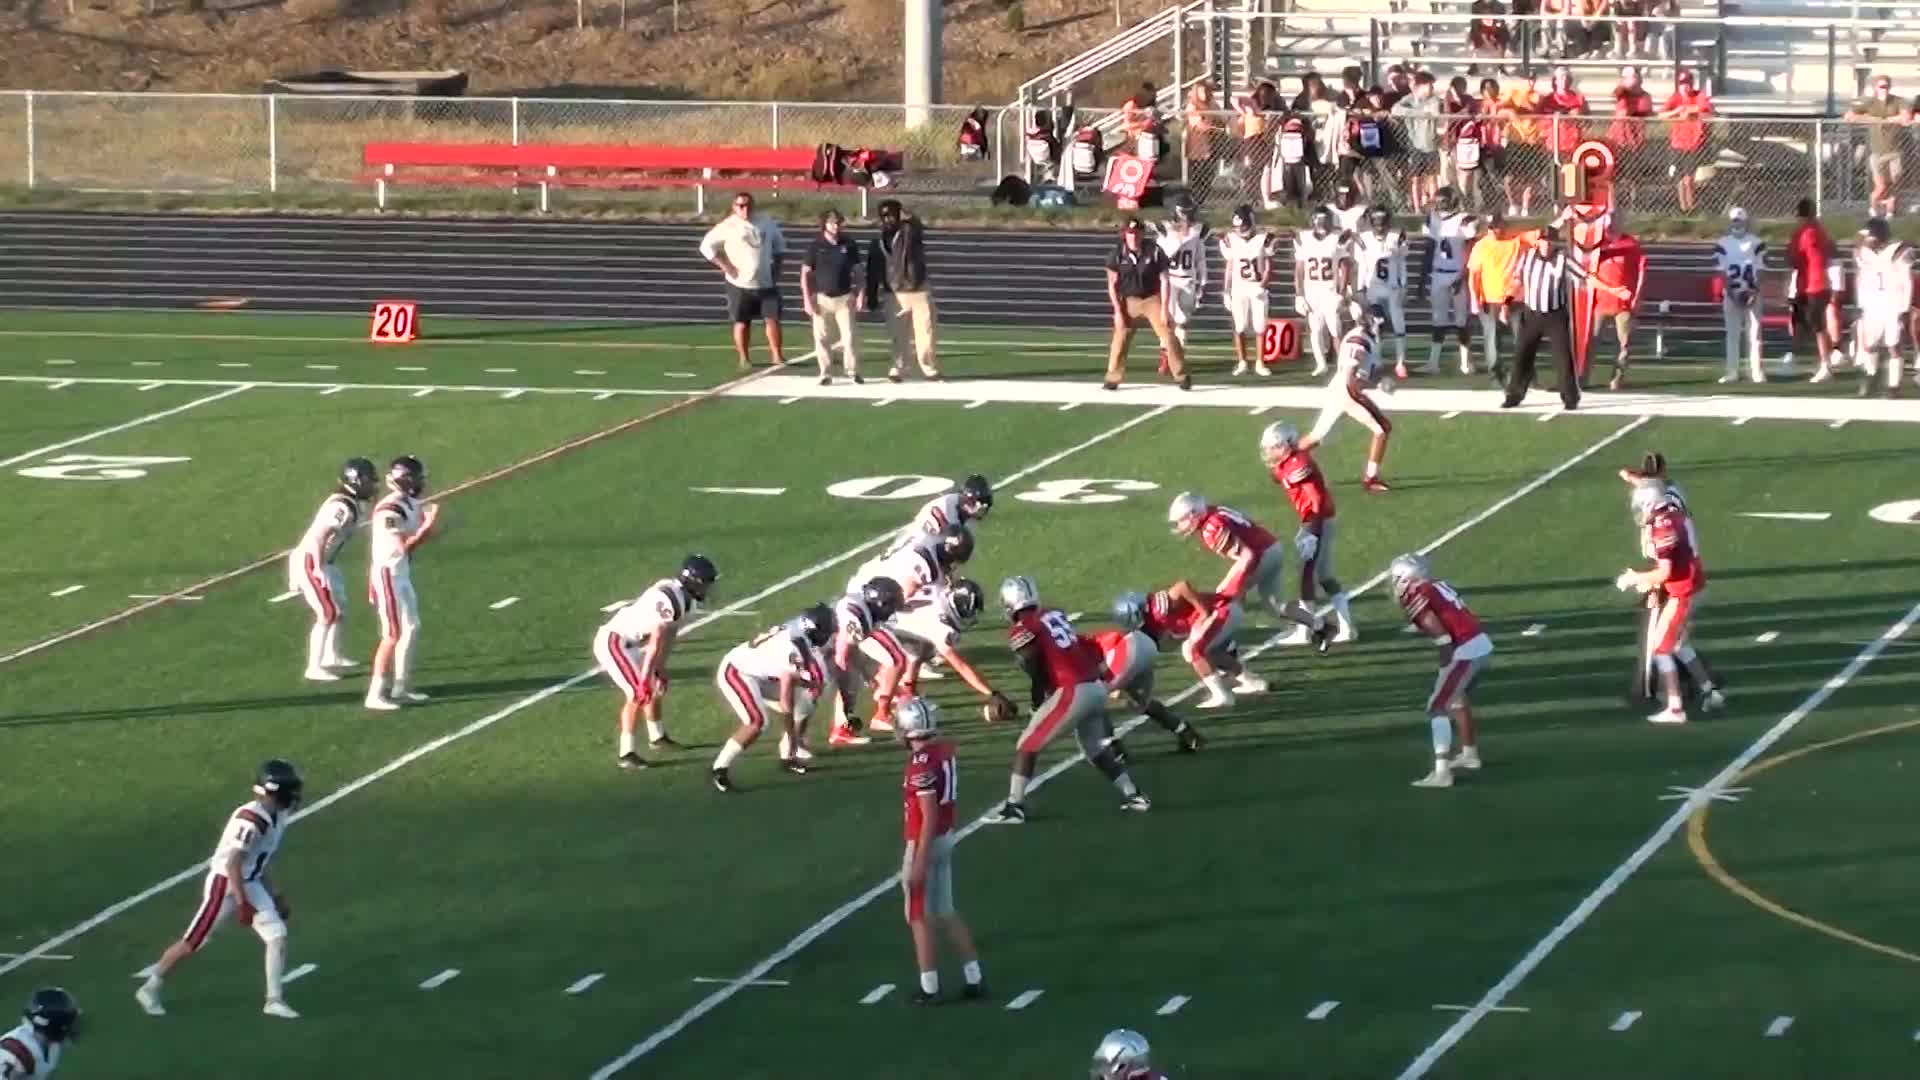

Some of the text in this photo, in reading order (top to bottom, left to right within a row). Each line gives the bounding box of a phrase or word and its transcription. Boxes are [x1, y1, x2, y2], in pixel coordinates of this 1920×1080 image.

[1440, 238, 1452, 260] 4
[1308, 257, 1333, 280] 22
[1376, 258, 1389, 280] 6
[1728, 264, 1756, 289] 24
[1877, 271, 1886, 291] 1
[376, 306, 408, 338] 20
